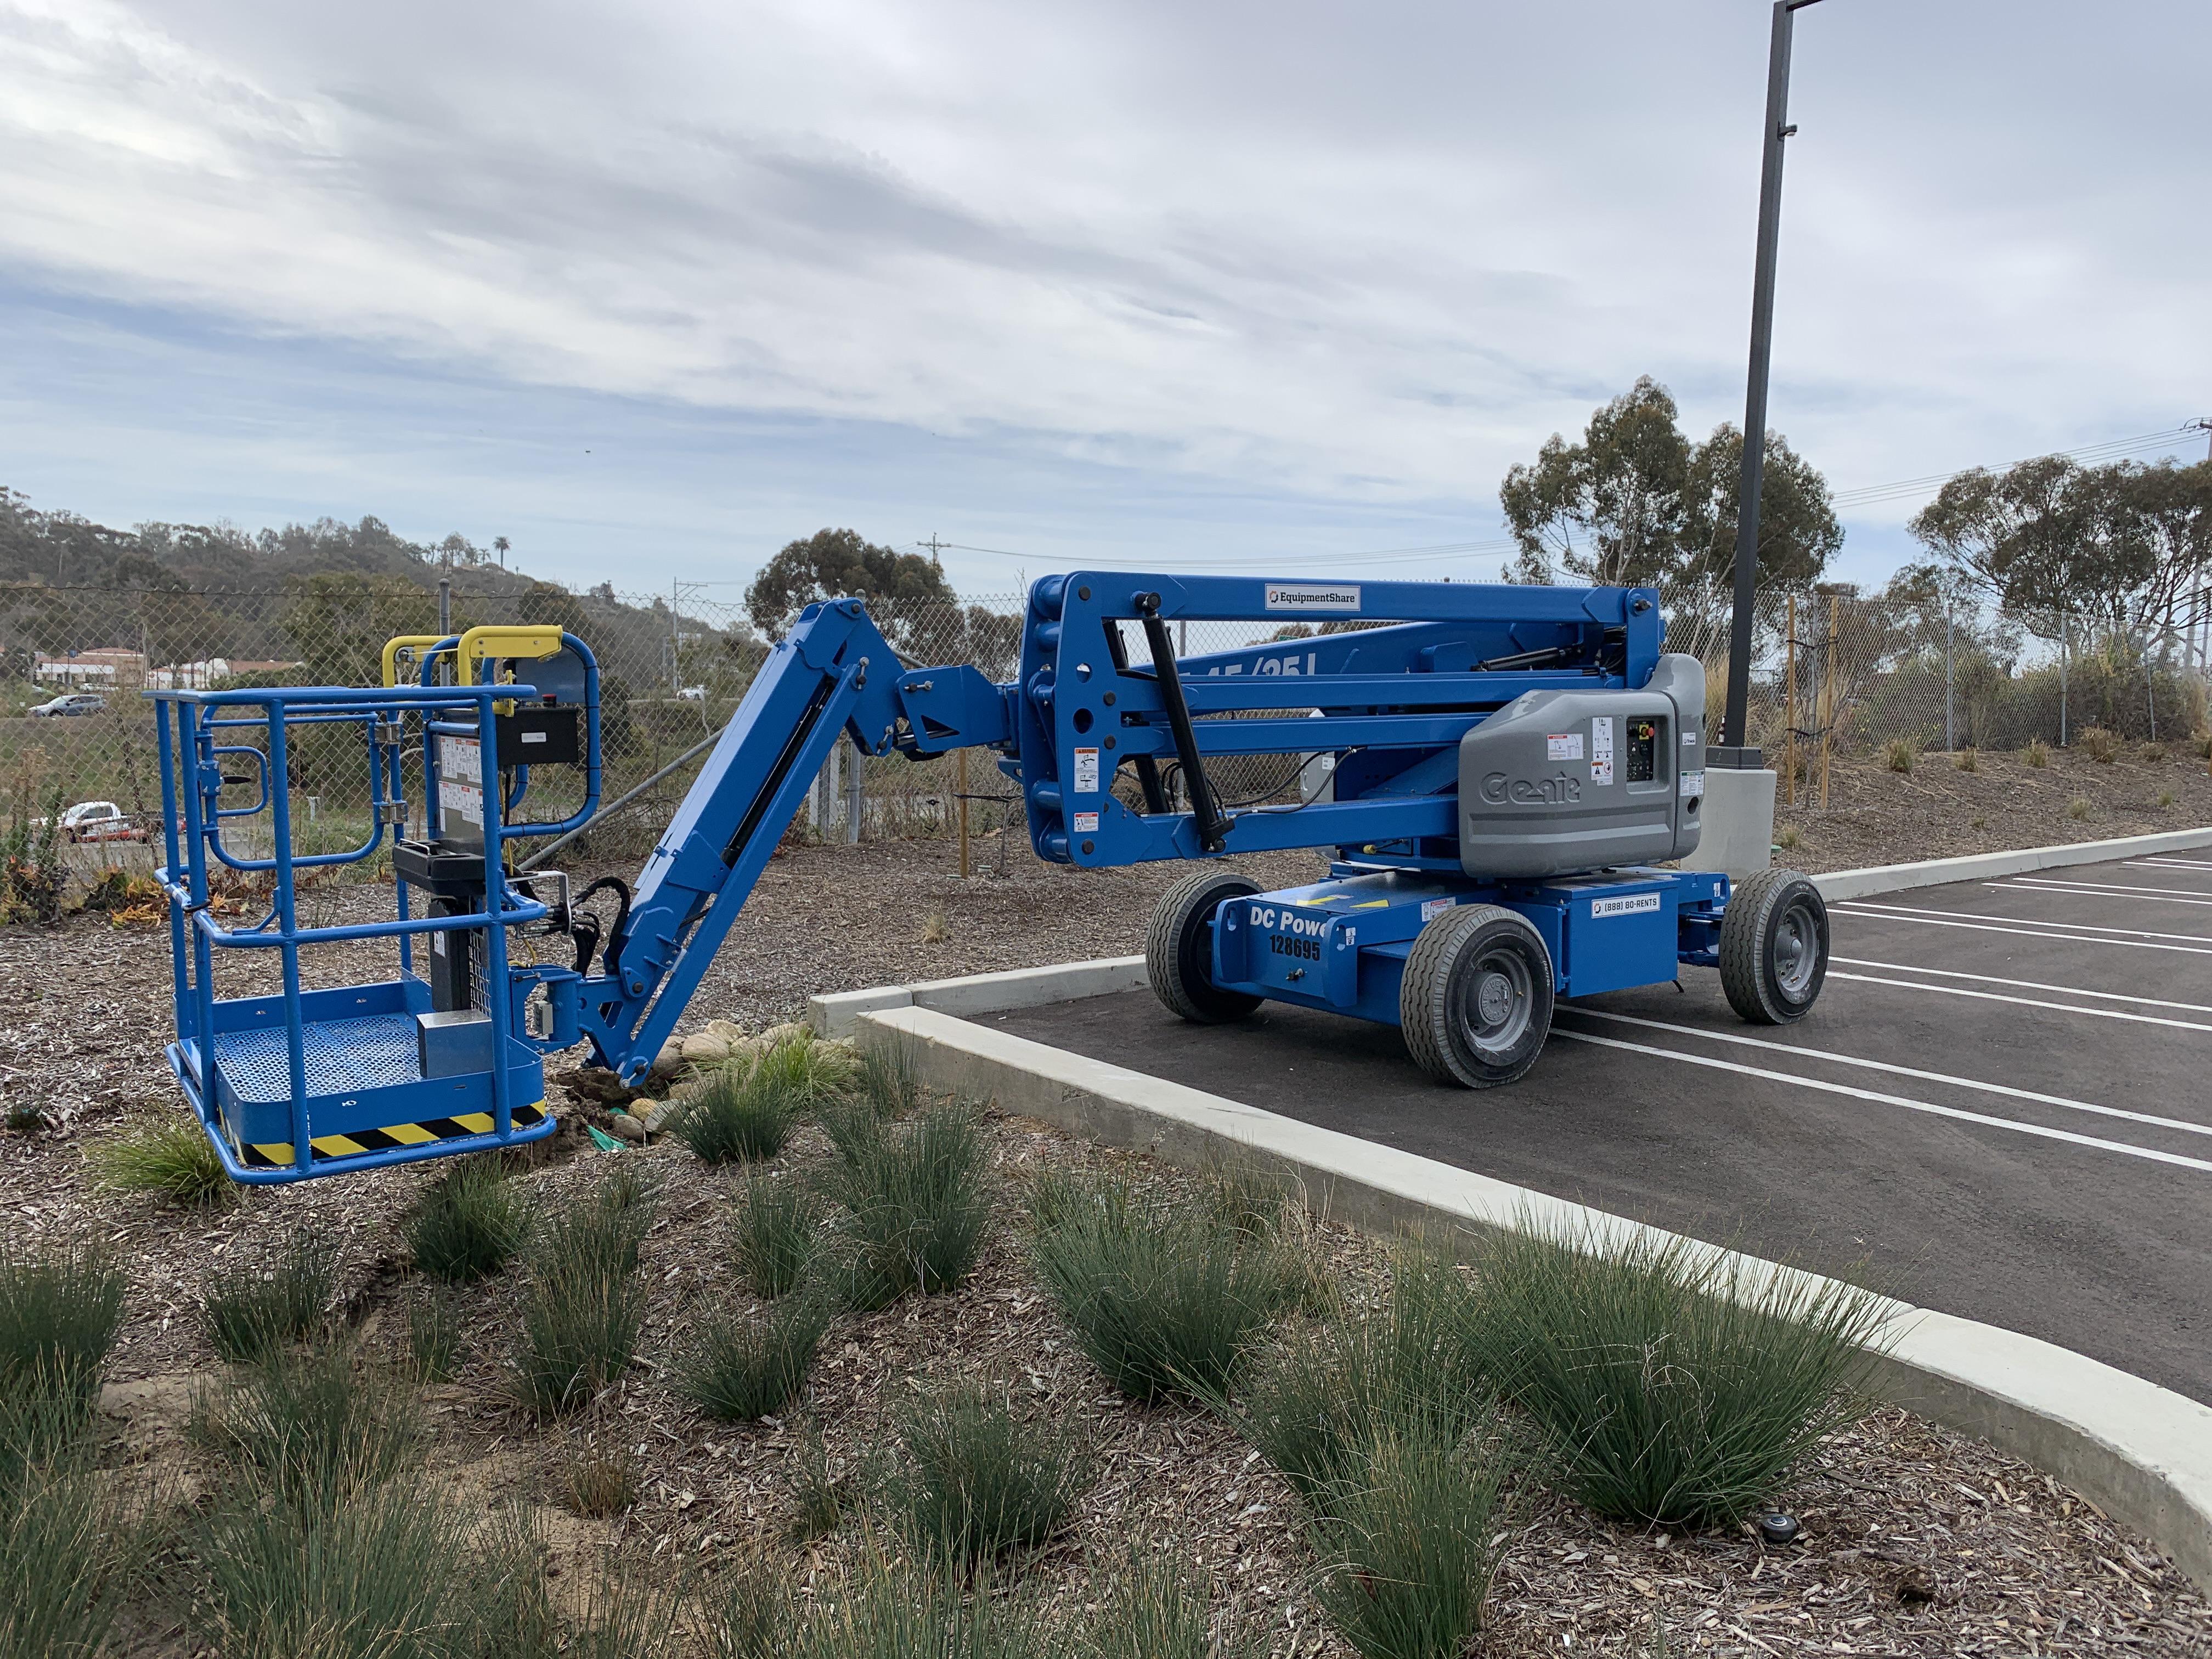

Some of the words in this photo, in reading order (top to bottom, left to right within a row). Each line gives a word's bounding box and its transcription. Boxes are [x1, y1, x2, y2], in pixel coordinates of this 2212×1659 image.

[1280, 592, 1355, 604] EquipmentShare
[1480, 771, 1581, 805] Genie
[1605, 901, 1623, 912] (888)
[1625, 898, 1657, 909] 80-RENTS
[1250, 906, 1275, 928] DC
[1269, 934, 1320, 961] 128695
